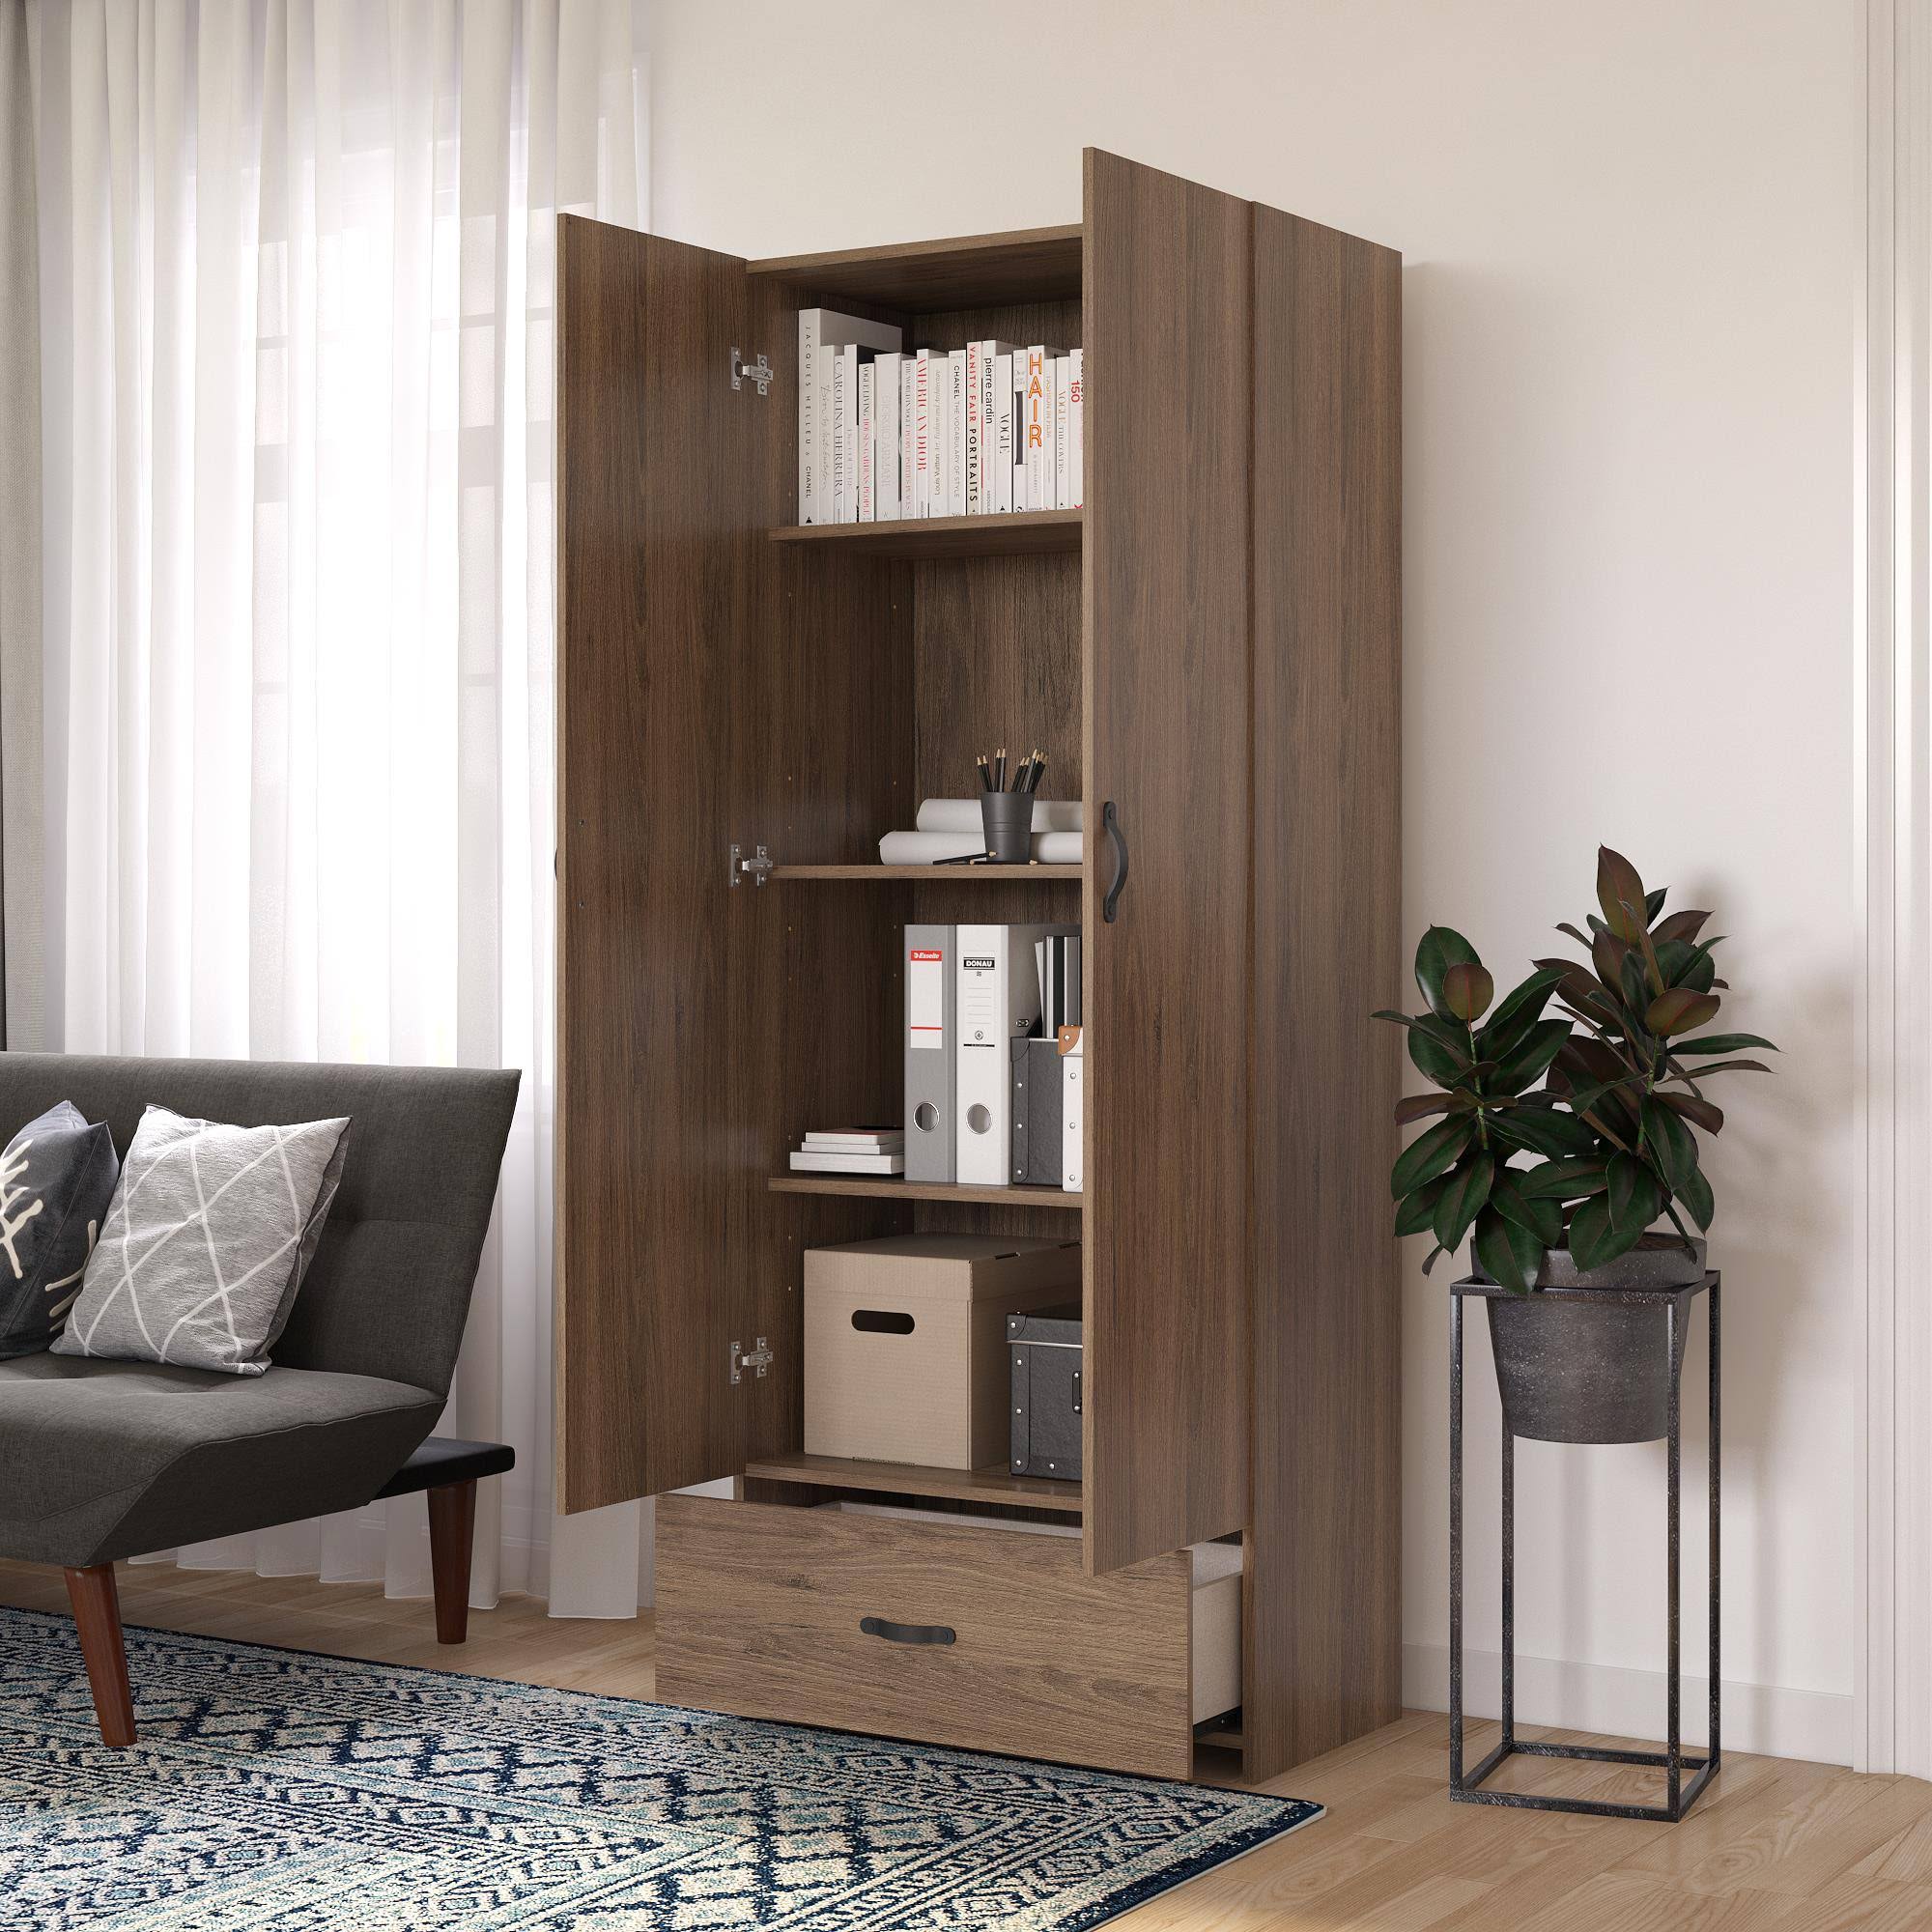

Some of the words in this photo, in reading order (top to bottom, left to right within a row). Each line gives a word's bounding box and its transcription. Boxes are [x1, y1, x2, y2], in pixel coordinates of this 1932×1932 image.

[983, 357, 992, 389] pierre
[1070, 380, 1080, 403] 150
[835, 361, 843, 431] CAROLINA
[917, 357, 927, 432] AMERICAN
[985, 391, 994, 424] cardin
[1029, 353, 1042, 448] HAIR
[1057, 389, 1066, 424] VOGUE
[999, 412, 1010, 455] VOGUE
[835, 435, 843, 497] HERRERA
[917, 436, 927, 471] DIOR
[953, 465, 960, 476] OF
[969, 428, 978, 502] PORTRAITS
